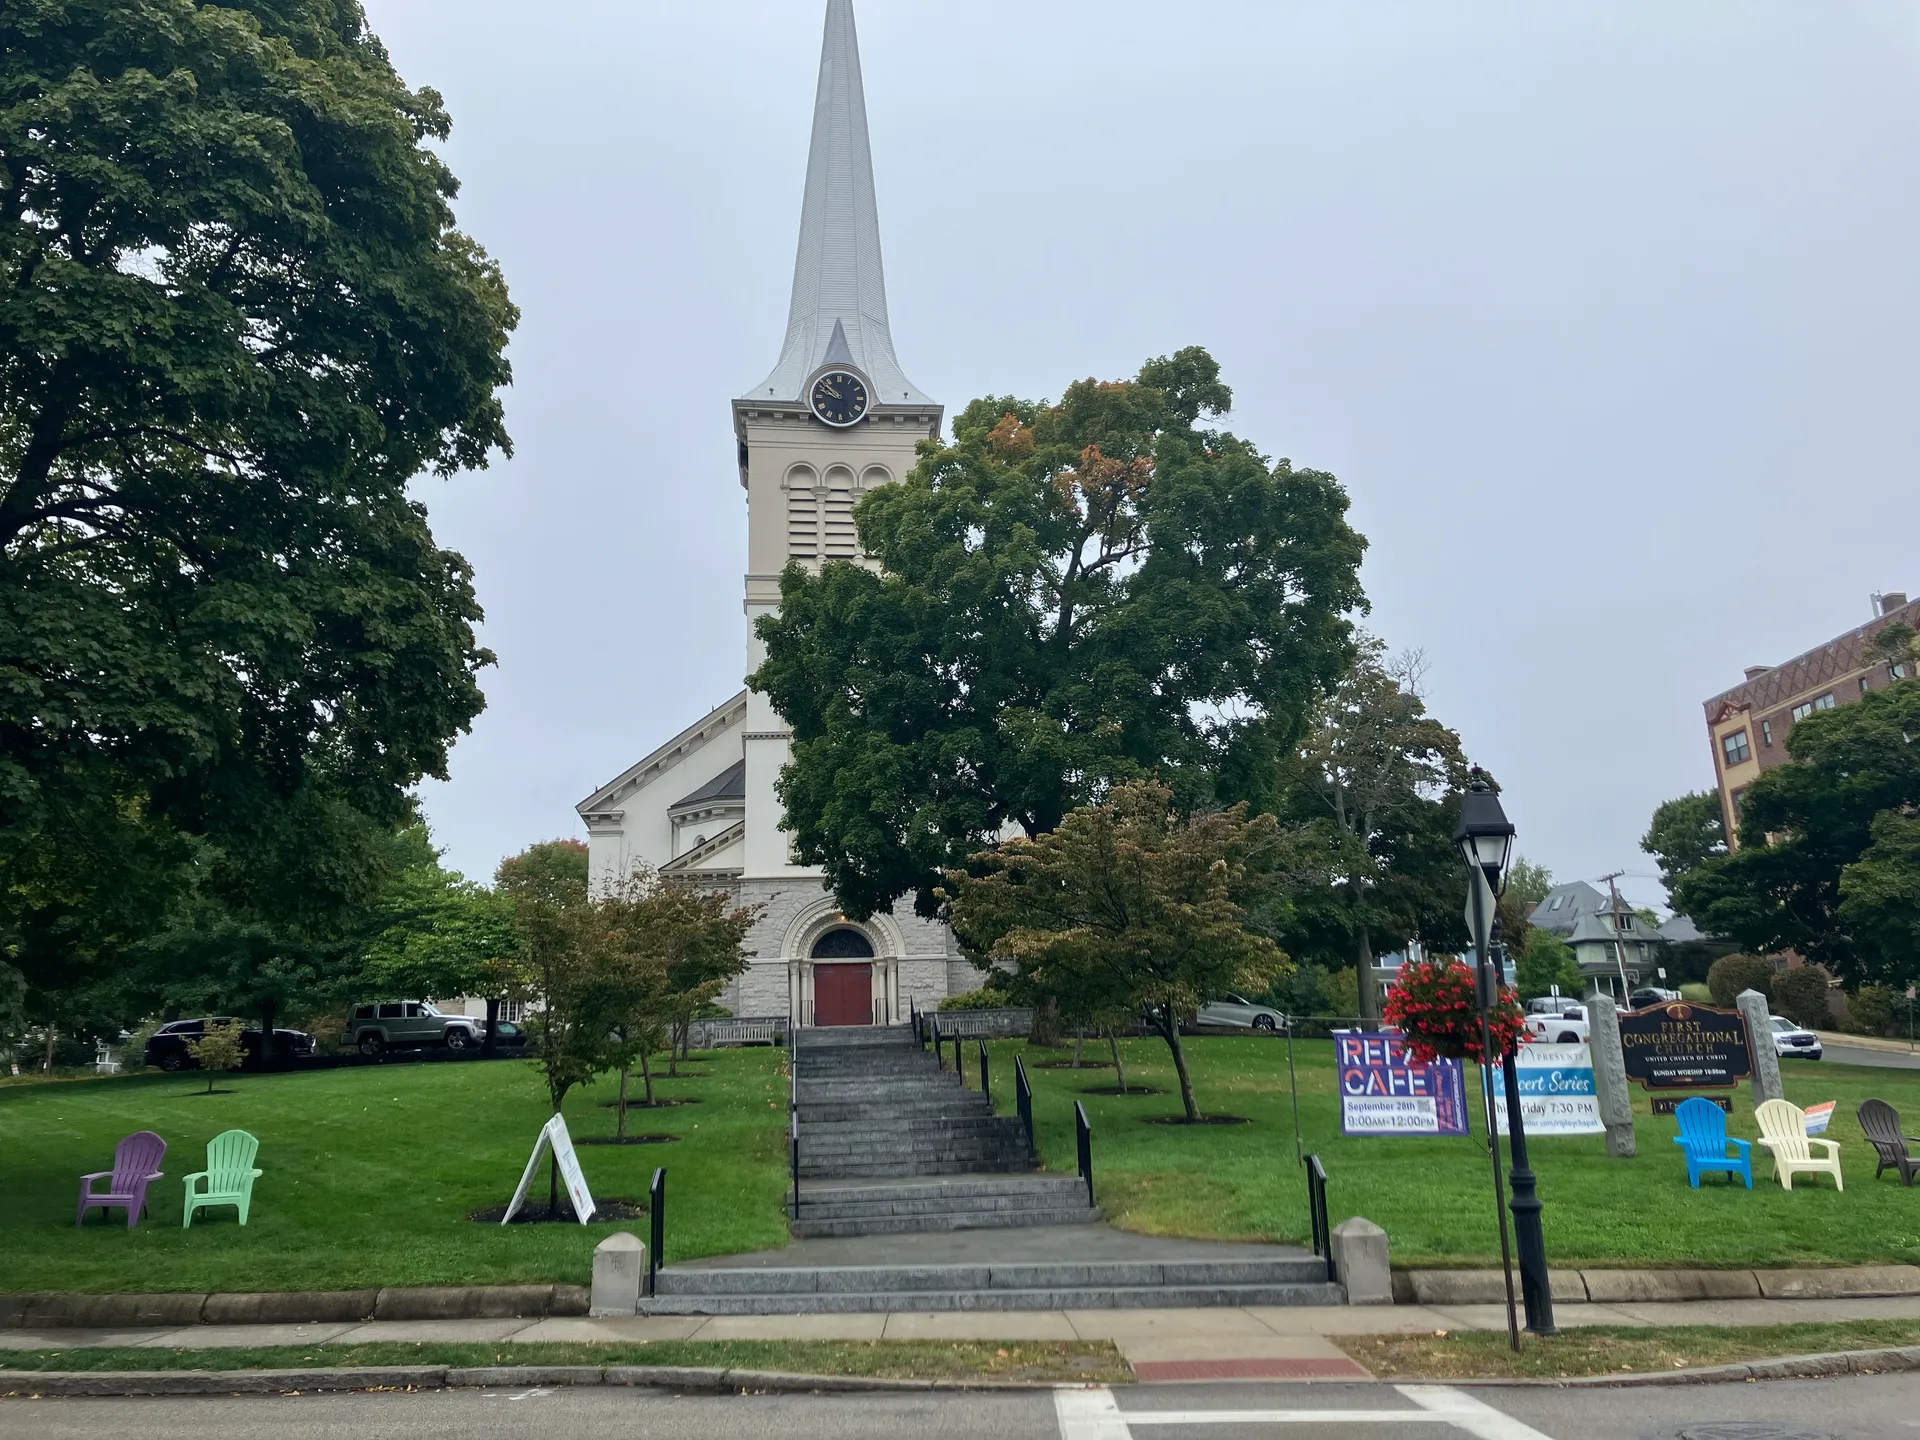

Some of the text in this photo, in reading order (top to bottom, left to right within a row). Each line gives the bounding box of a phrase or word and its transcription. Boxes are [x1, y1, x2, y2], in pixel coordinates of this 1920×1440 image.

[1661, 1021, 1701, 1033] FIRST
[1623, 1031, 1744, 1048] CONGREGATIONAL
[1342, 1039, 1452, 1066] REP
[1655, 1043, 1714, 1055] CHURCH
[1537, 1053, 1584, 1061] PRESENTS
[1653, 1069, 1676, 1077] SUNDAY
[1677, 1069, 1703, 1077] WORSHIP
[1345, 1069, 1428, 1096] CAFE
[1493, 1070, 1590, 1092] Cocert Series
[1348, 1101, 1416, 1114] September 28th
[1520, 1101, 1547, 1117] riday
[1551, 1102, 1574, 1114] 7:30
[1577, 1102, 1594, 1113] PM
